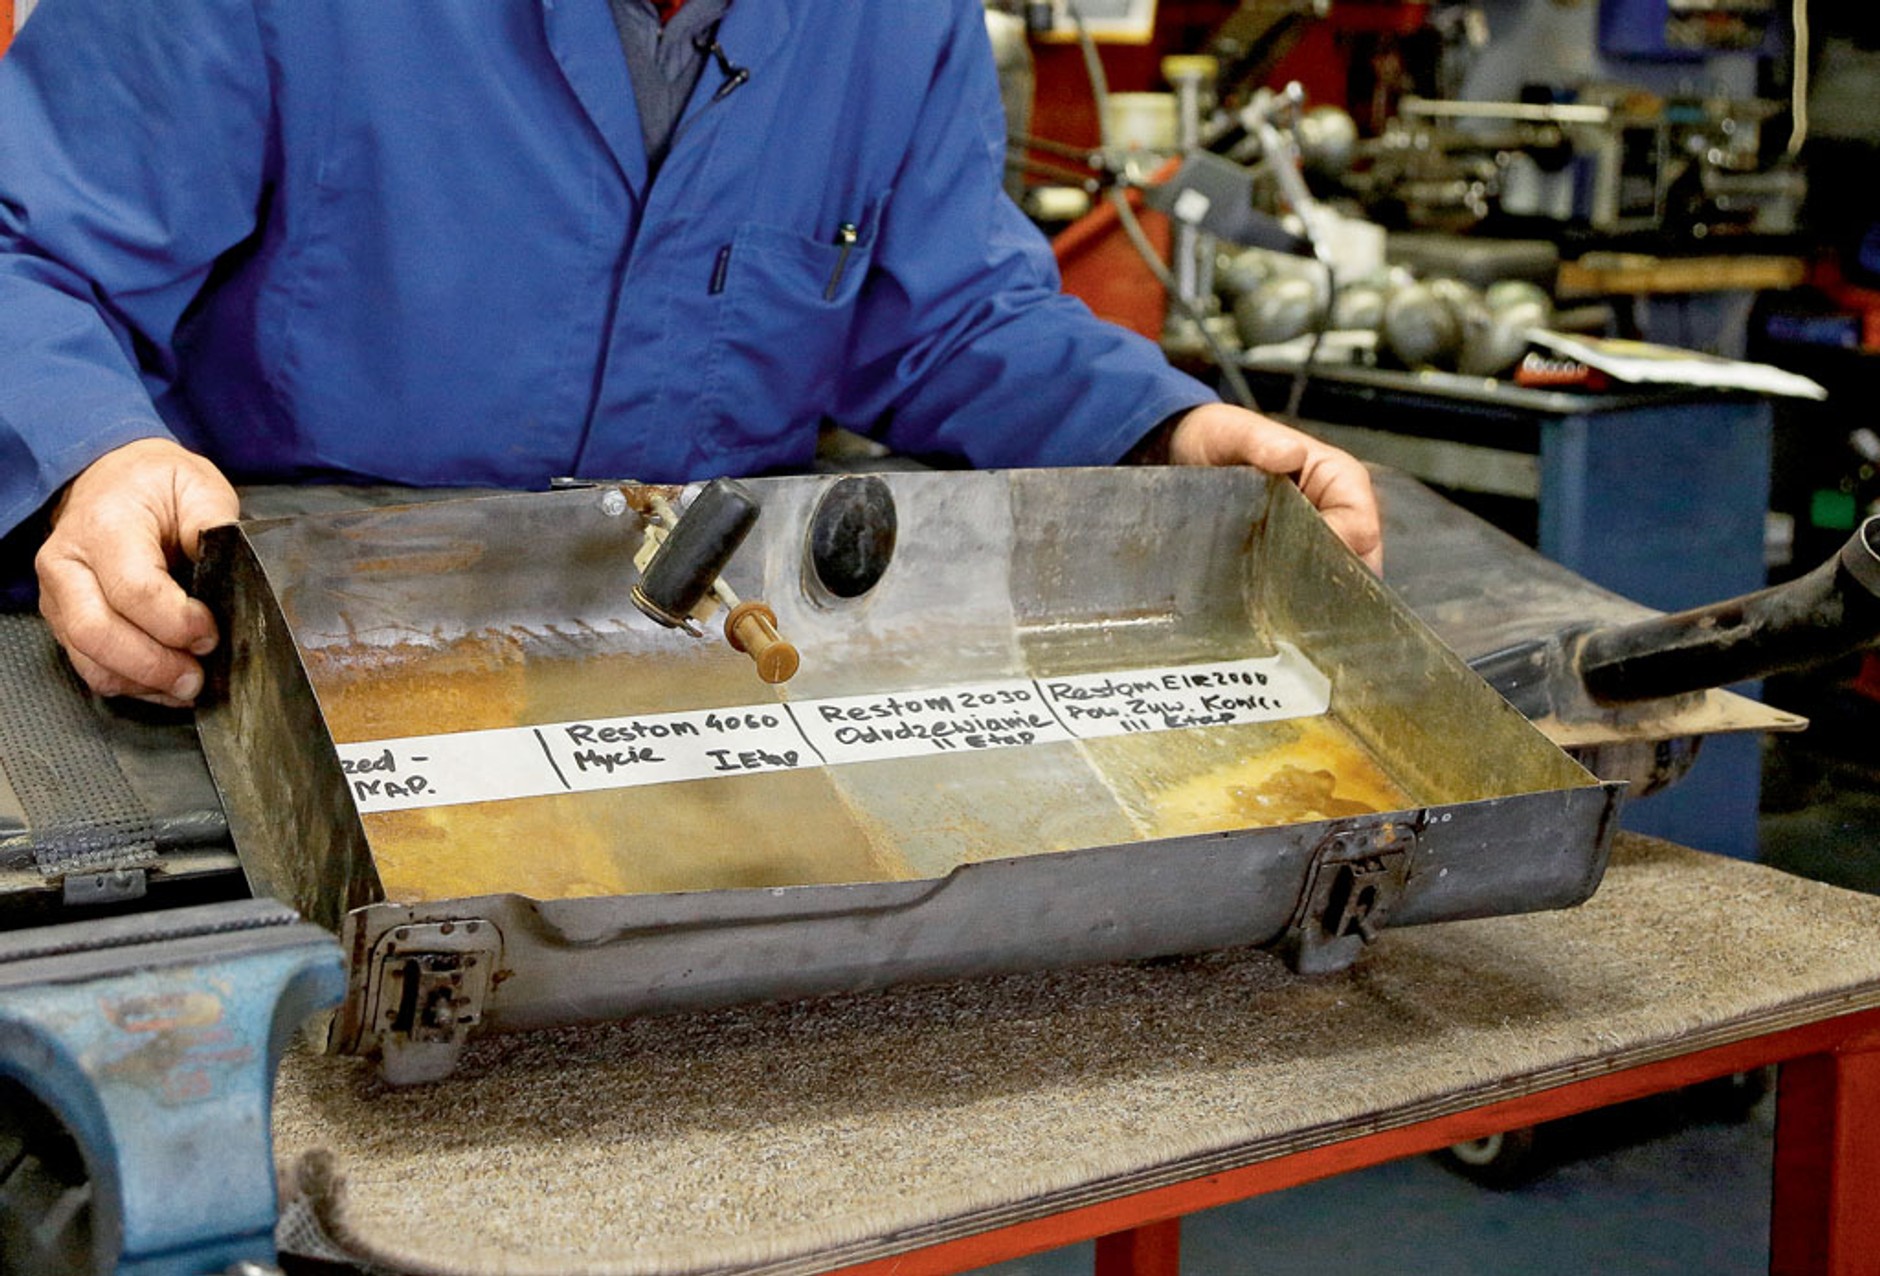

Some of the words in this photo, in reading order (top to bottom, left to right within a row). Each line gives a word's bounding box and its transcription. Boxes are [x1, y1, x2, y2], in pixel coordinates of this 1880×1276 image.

[818, 697, 956, 724] Restom
[957, 689, 1031, 709] 2030
[565, 720, 700, 747] Restom
[705, 714, 778, 733] 4060
